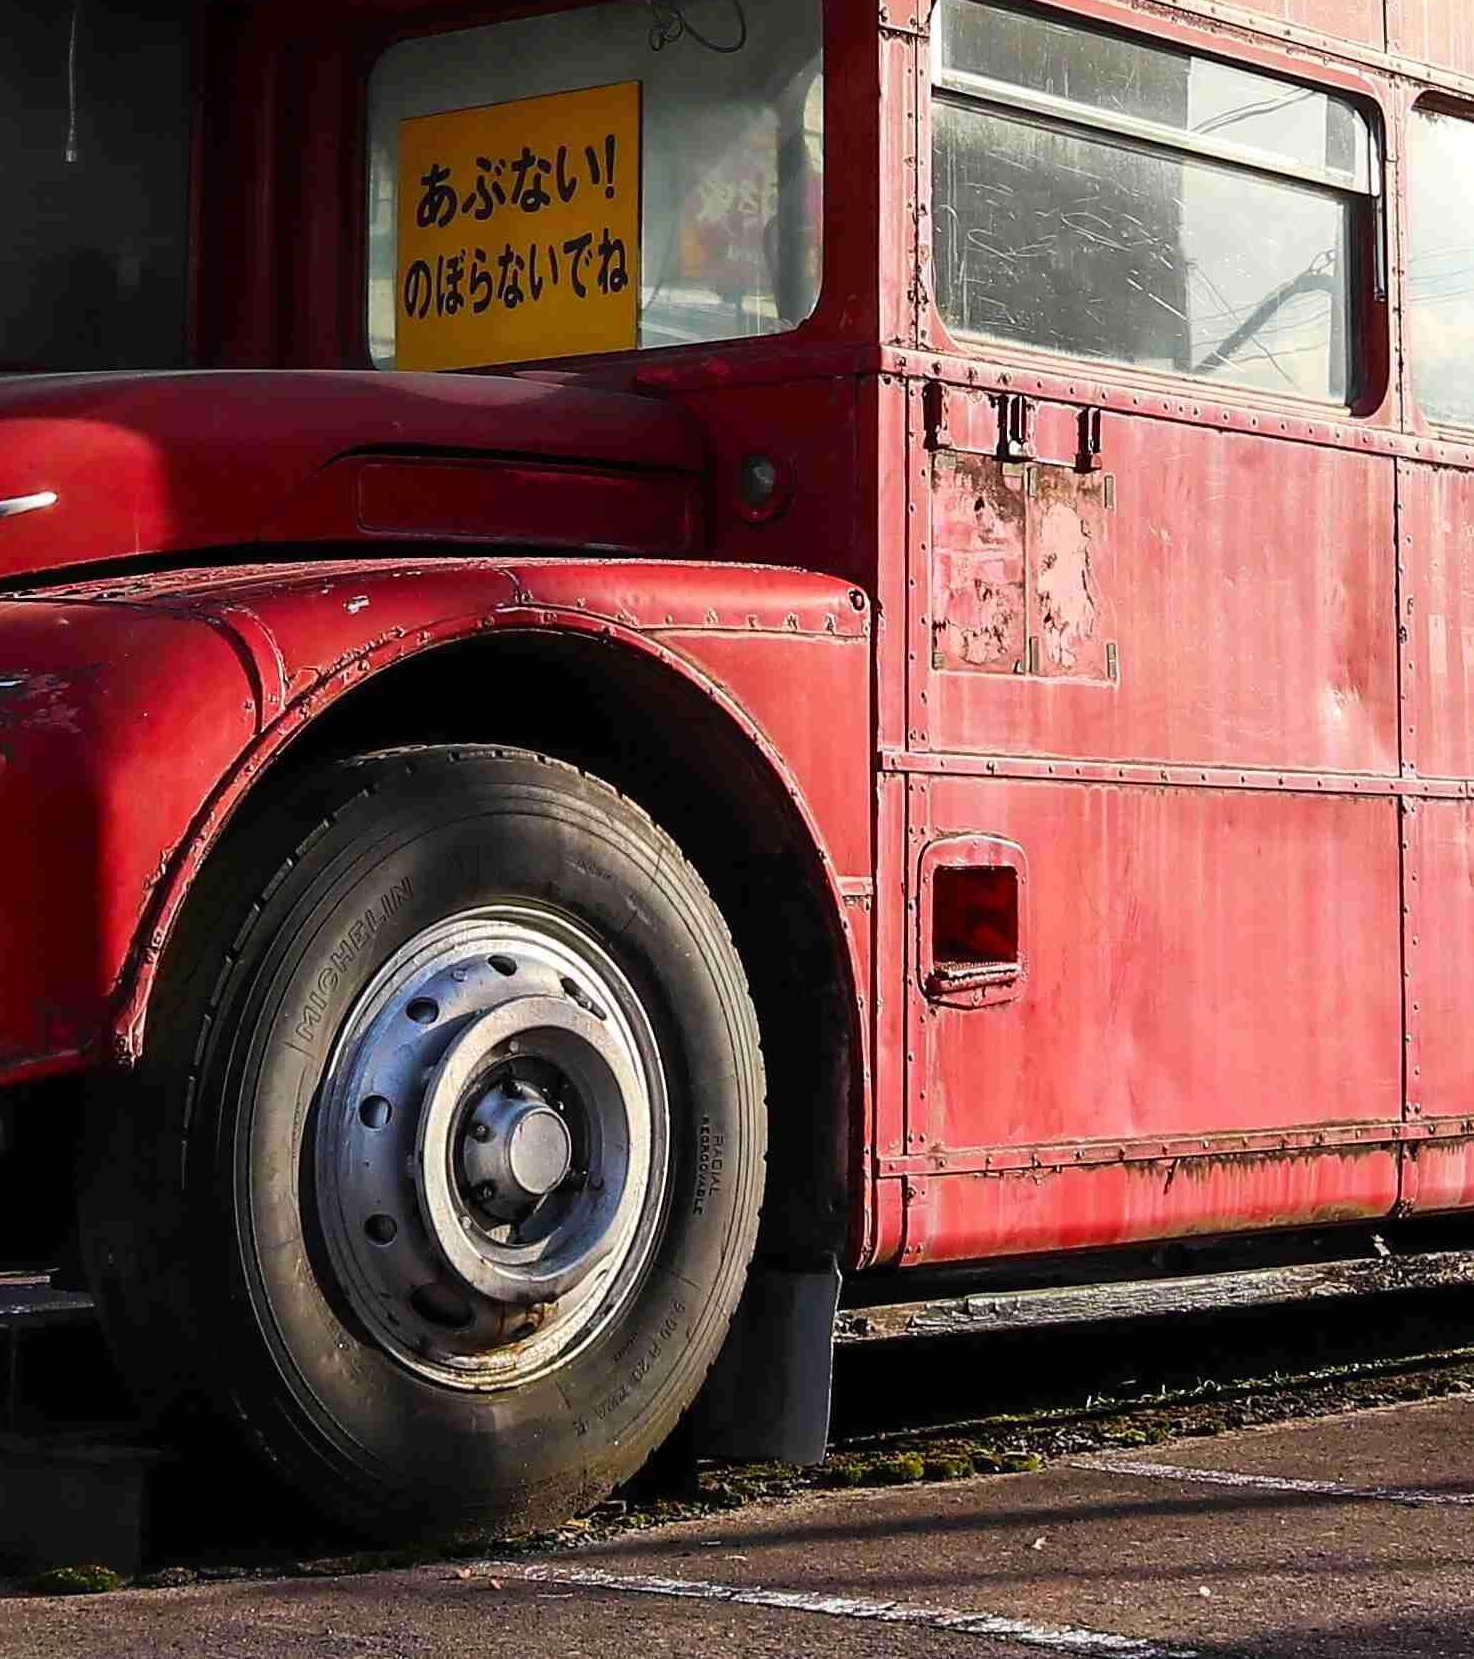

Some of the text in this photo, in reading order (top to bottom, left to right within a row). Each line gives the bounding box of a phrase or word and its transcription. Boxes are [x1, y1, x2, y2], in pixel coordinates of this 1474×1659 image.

[416, 134, 617, 228] あぶない!
[404, 228, 629, 319] のぼらないでね
[295, 876, 414, 1042] MICHELIN
